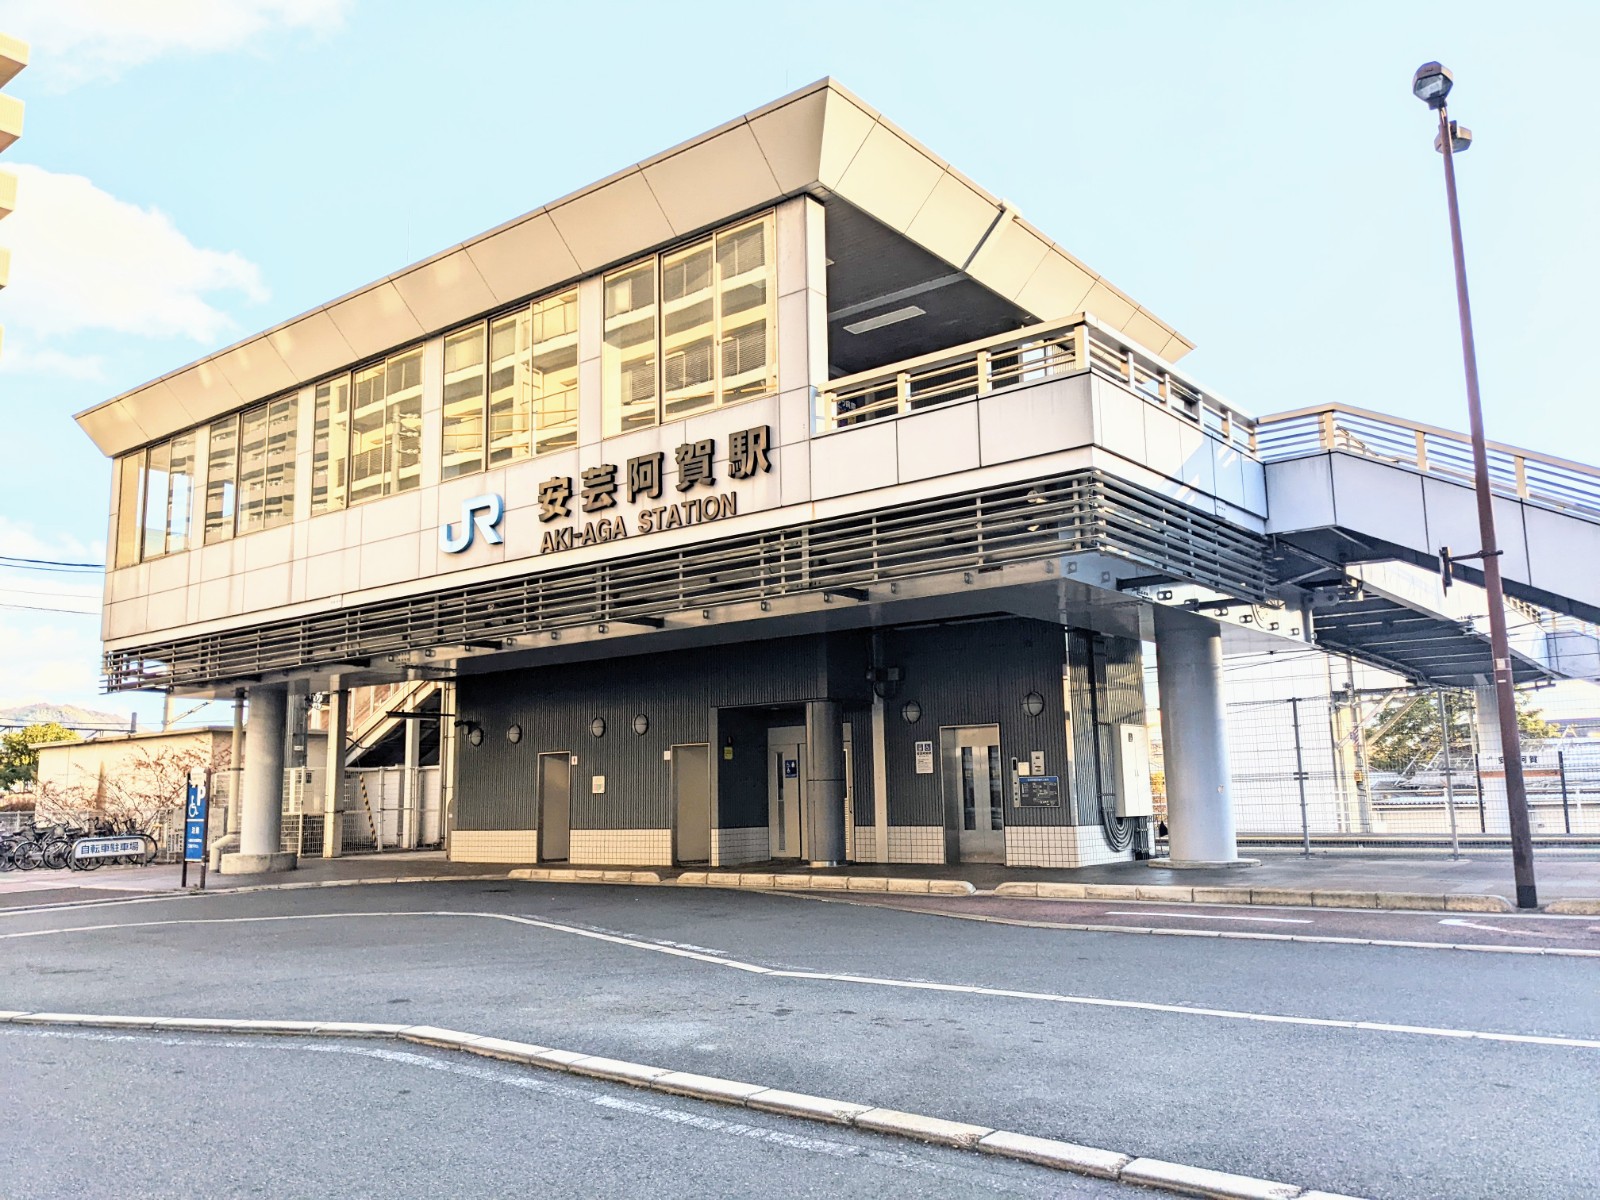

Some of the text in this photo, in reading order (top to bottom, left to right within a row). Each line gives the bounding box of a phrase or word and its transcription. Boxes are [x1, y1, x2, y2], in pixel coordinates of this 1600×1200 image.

[538, 424, 772, 523] 安芸阿賀駅
[439, 492, 505, 554] JR
[540, 491, 738, 553] AKI-AGA STATION
[196, 784, 206, 806] P
[80, 841, 139, 855] 自転車駐車場
